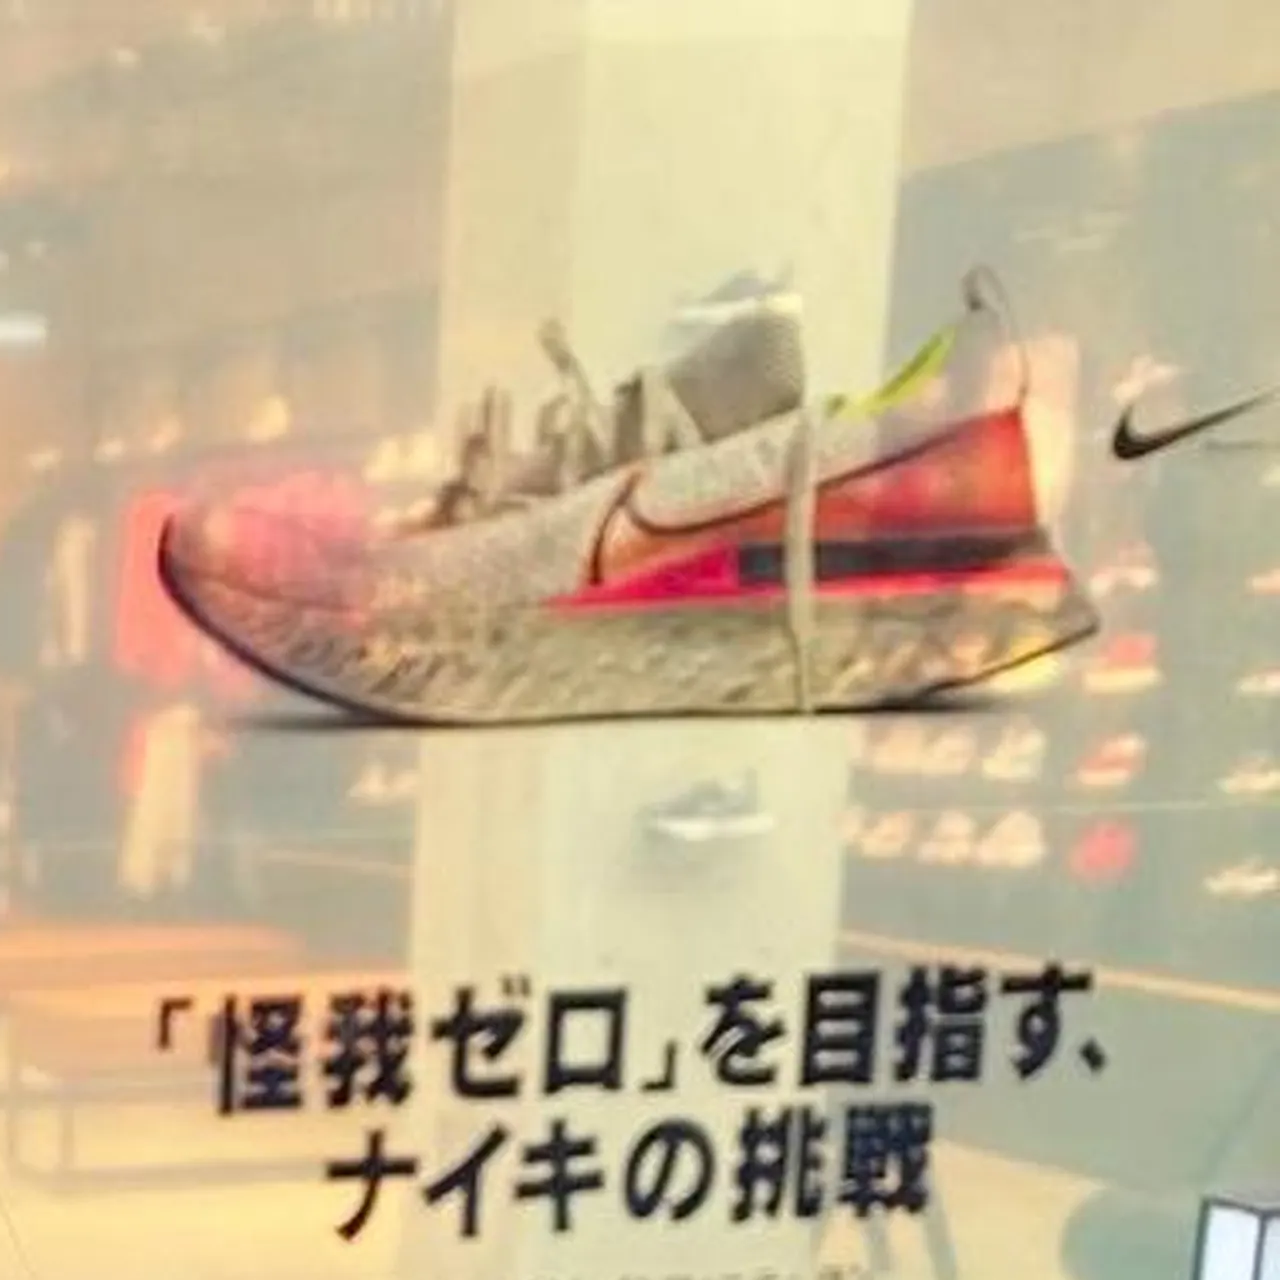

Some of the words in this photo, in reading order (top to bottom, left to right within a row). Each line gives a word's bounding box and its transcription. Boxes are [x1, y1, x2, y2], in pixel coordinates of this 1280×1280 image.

[156, 961, 1107, 1117] 「怪我ゼロ」を目指す、
[326, 1104, 934, 1241] ナイキの挑戦
